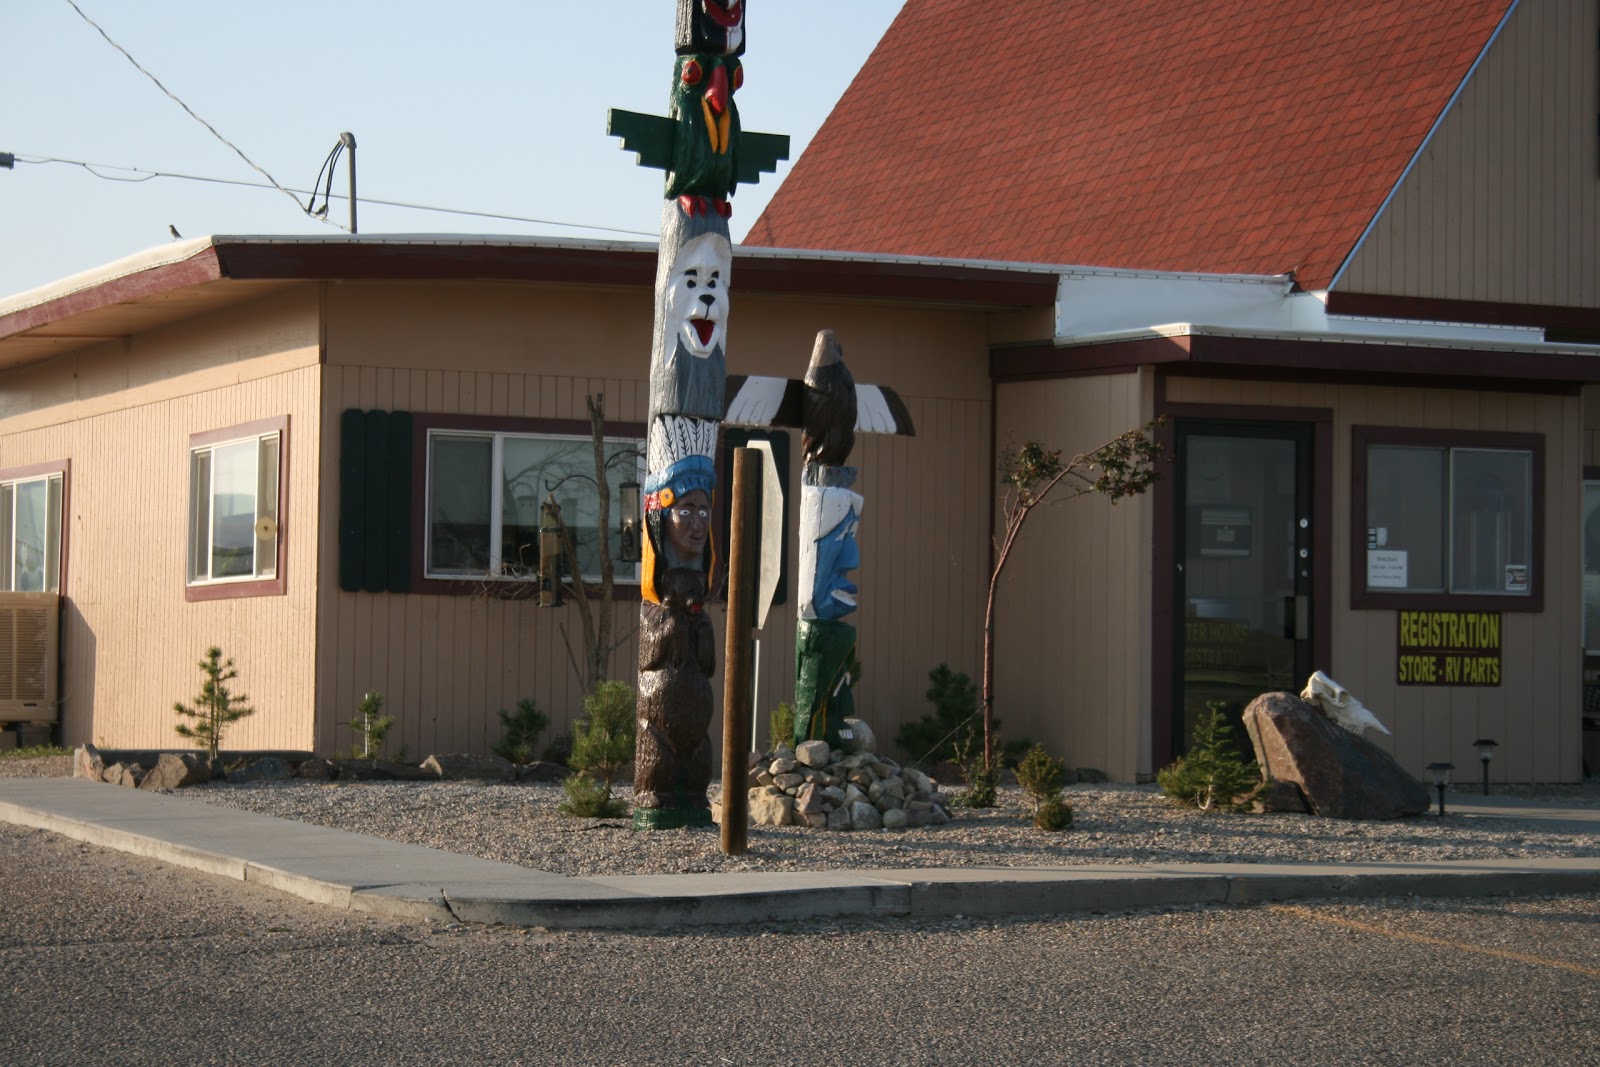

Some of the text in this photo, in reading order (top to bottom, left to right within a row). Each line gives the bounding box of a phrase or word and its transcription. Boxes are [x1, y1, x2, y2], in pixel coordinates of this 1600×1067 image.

[1400, 611, 1499, 648] REGISTRATION
[1399, 655, 1437, 682] STORE
[1445, 656, 1462, 682] RV
[1463, 657, 1499, 683] PARTS
